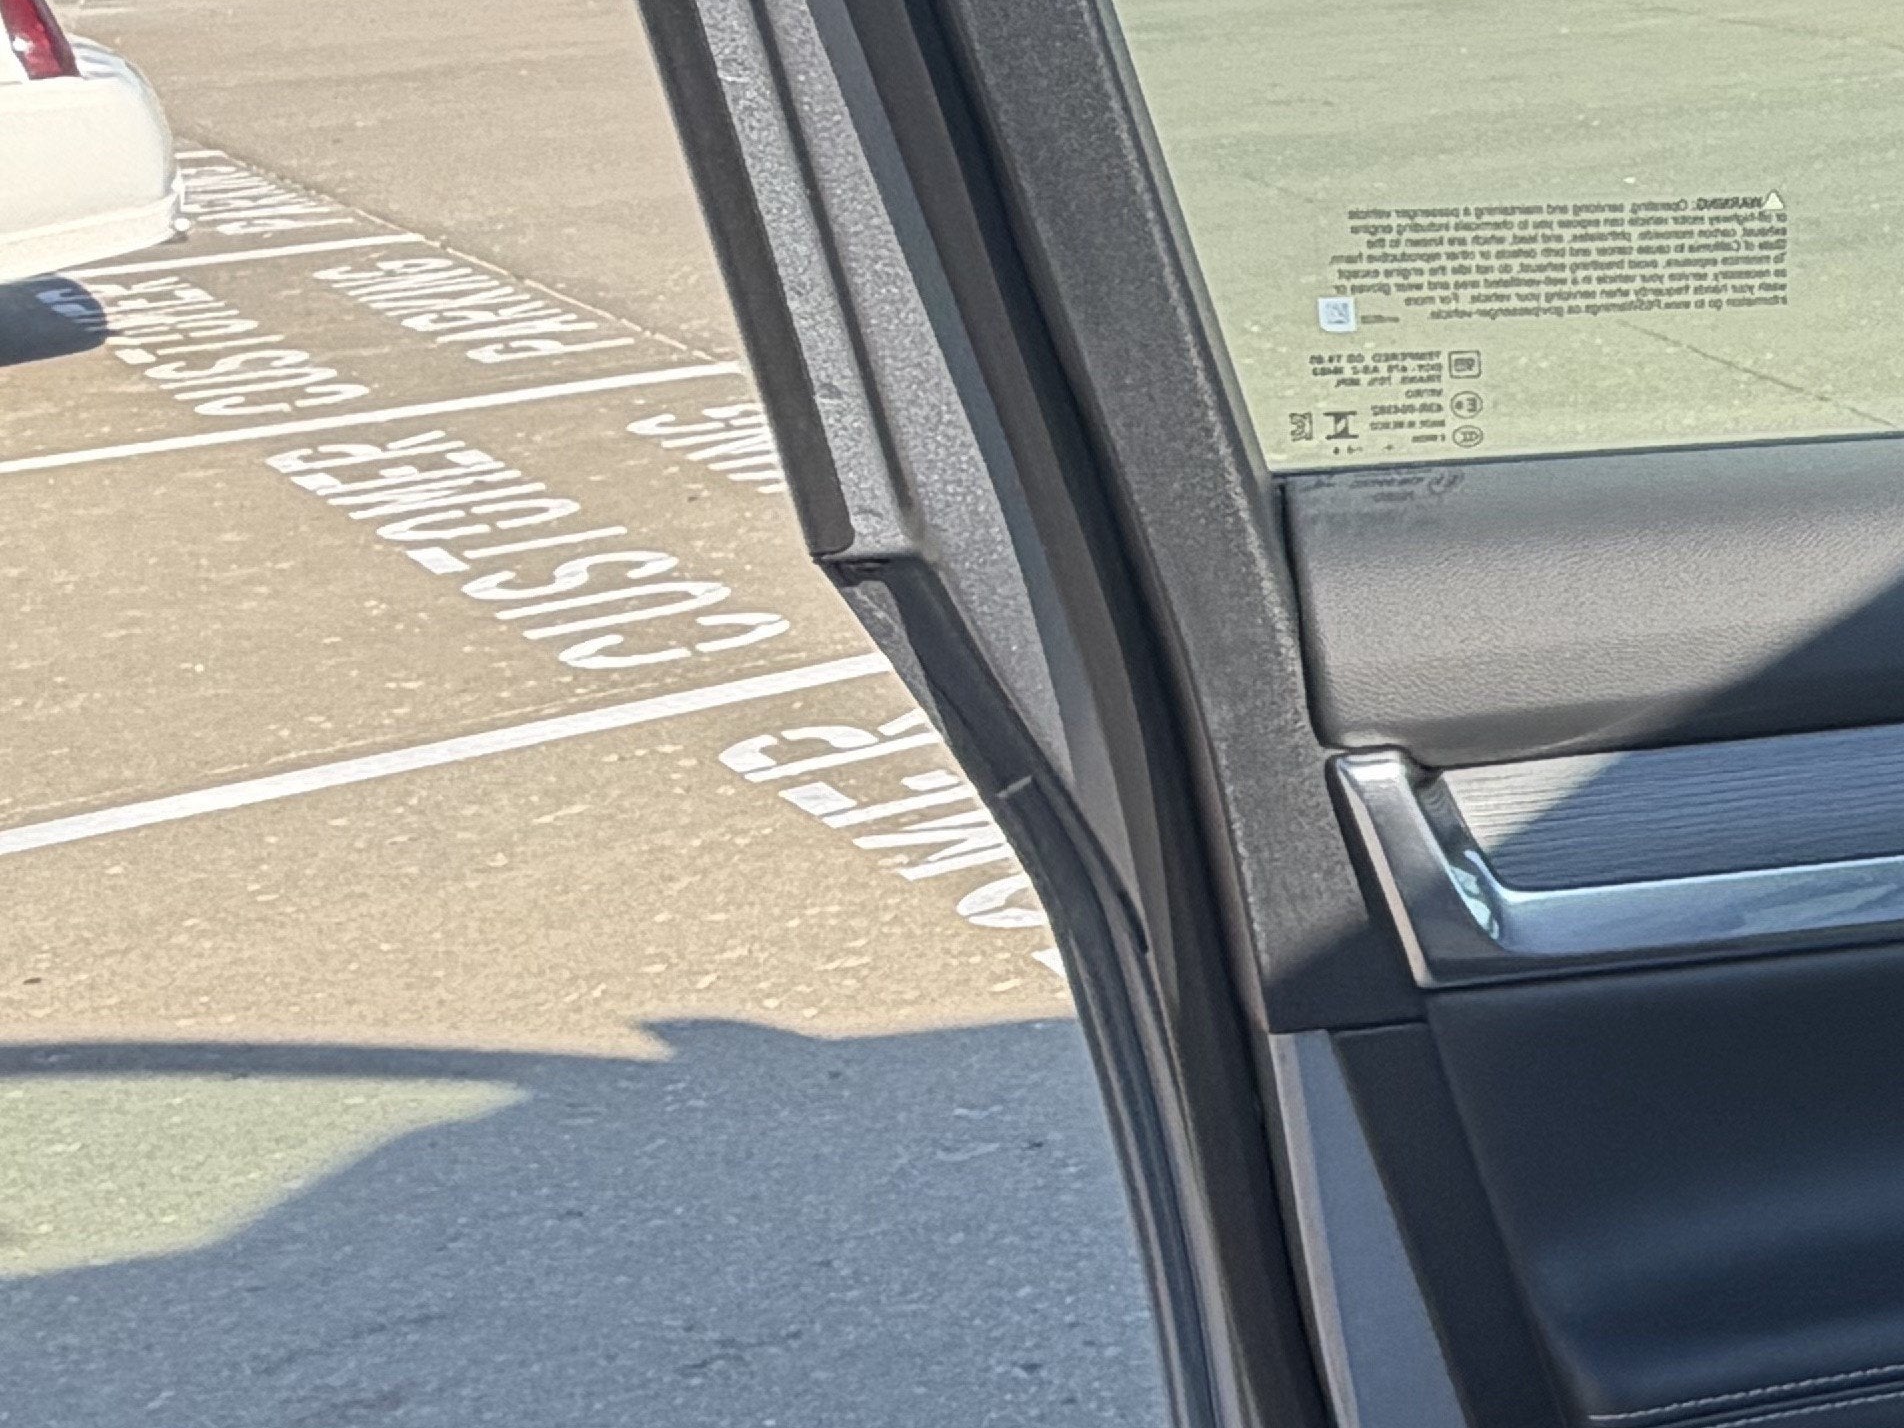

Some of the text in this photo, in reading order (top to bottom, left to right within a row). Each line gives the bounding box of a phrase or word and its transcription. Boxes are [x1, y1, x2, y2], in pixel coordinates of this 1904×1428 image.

[35, 275, 370, 416] CUSTOMER
[313, 257, 635, 364] PARKING
[264, 430, 791, 669] CUSTOMER
